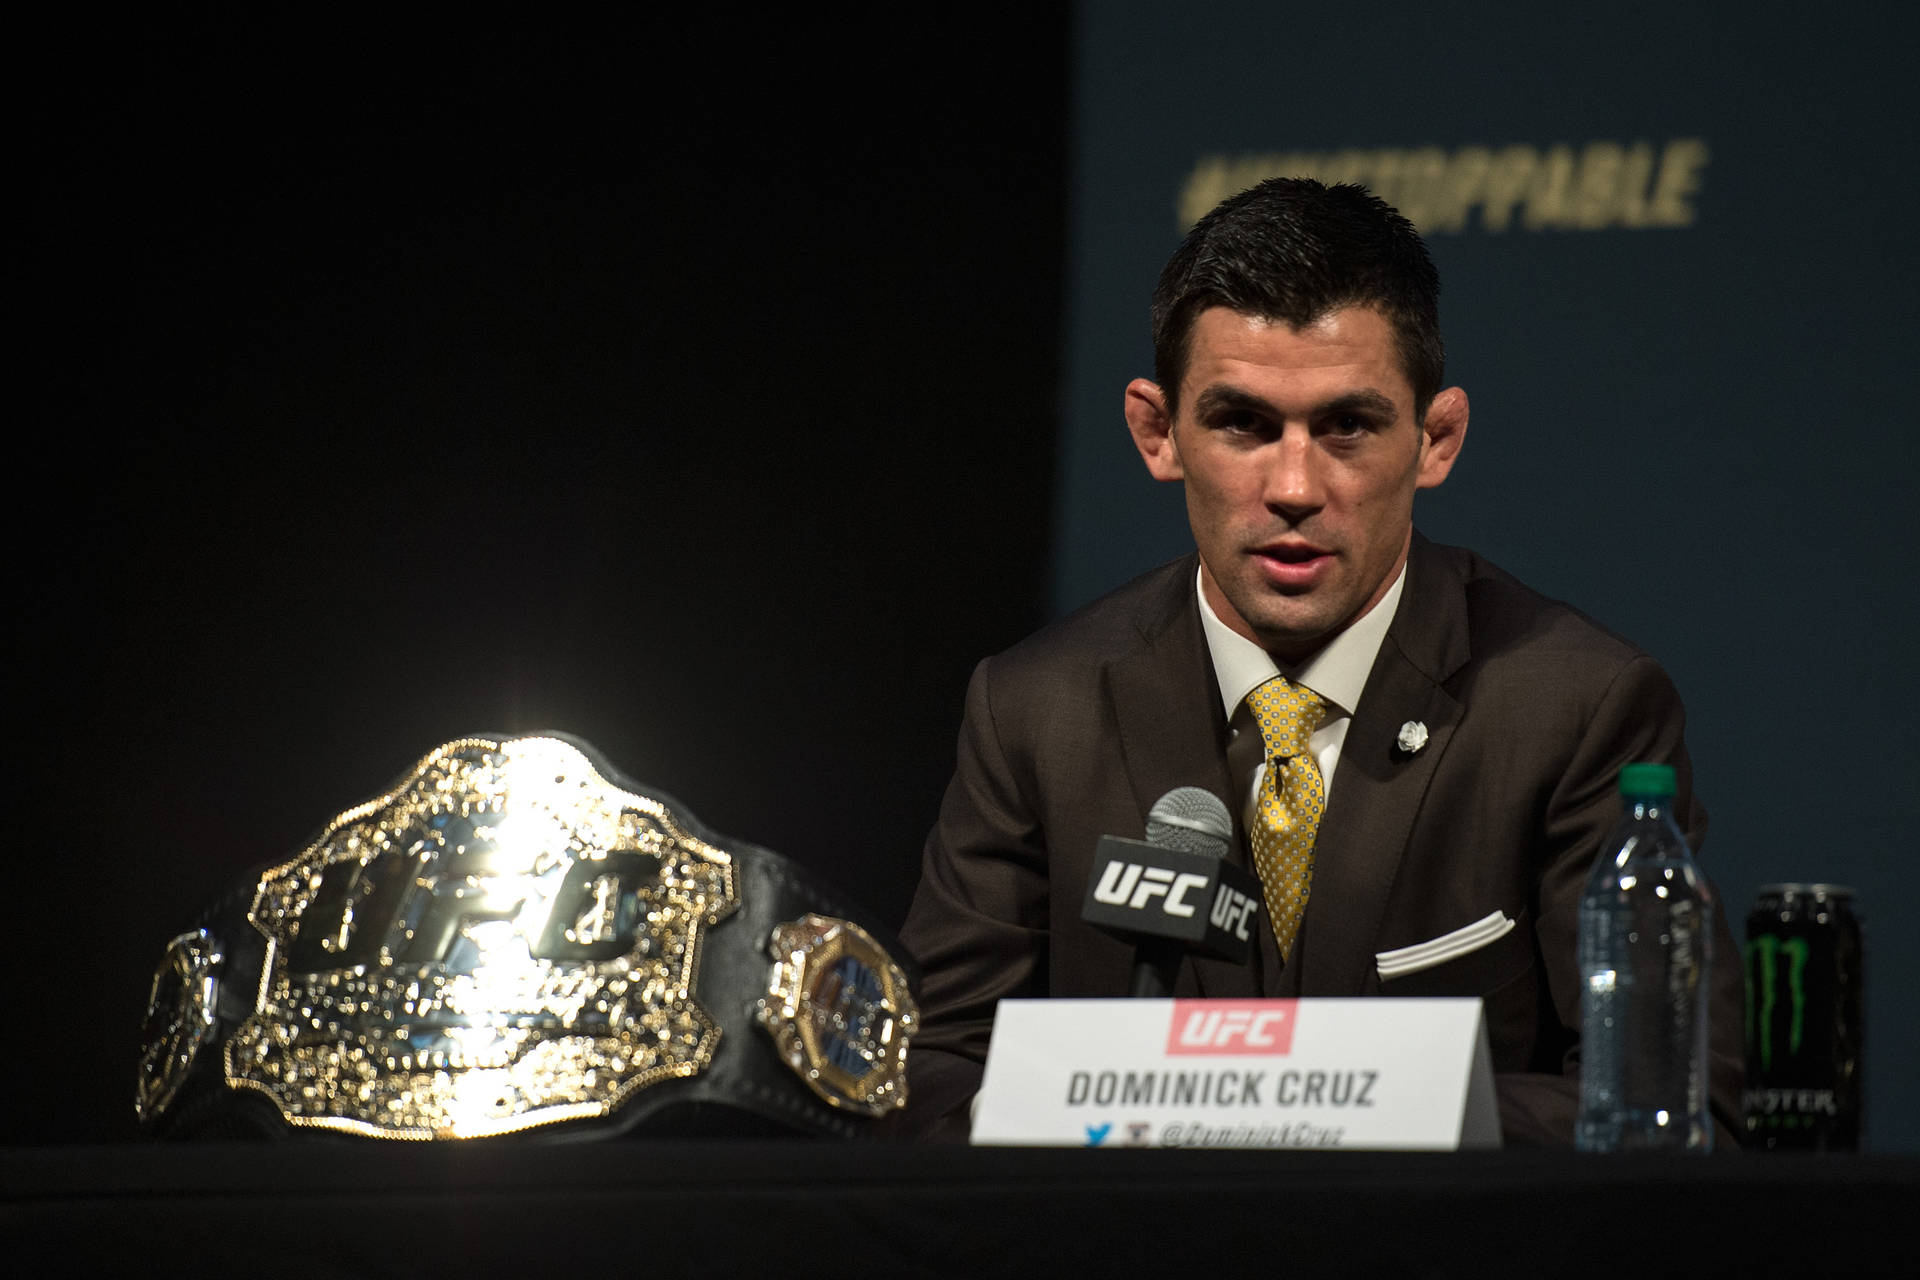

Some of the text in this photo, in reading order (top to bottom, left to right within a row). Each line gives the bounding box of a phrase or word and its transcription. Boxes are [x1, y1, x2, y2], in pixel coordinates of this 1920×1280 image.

[1093, 859, 1209, 918] UFC
[1210, 883, 1258, 942] UFC
[1179, 1010, 1284, 1046] UFC
[1066, 1071, 1380, 1107] DOMINICK CRUZ
